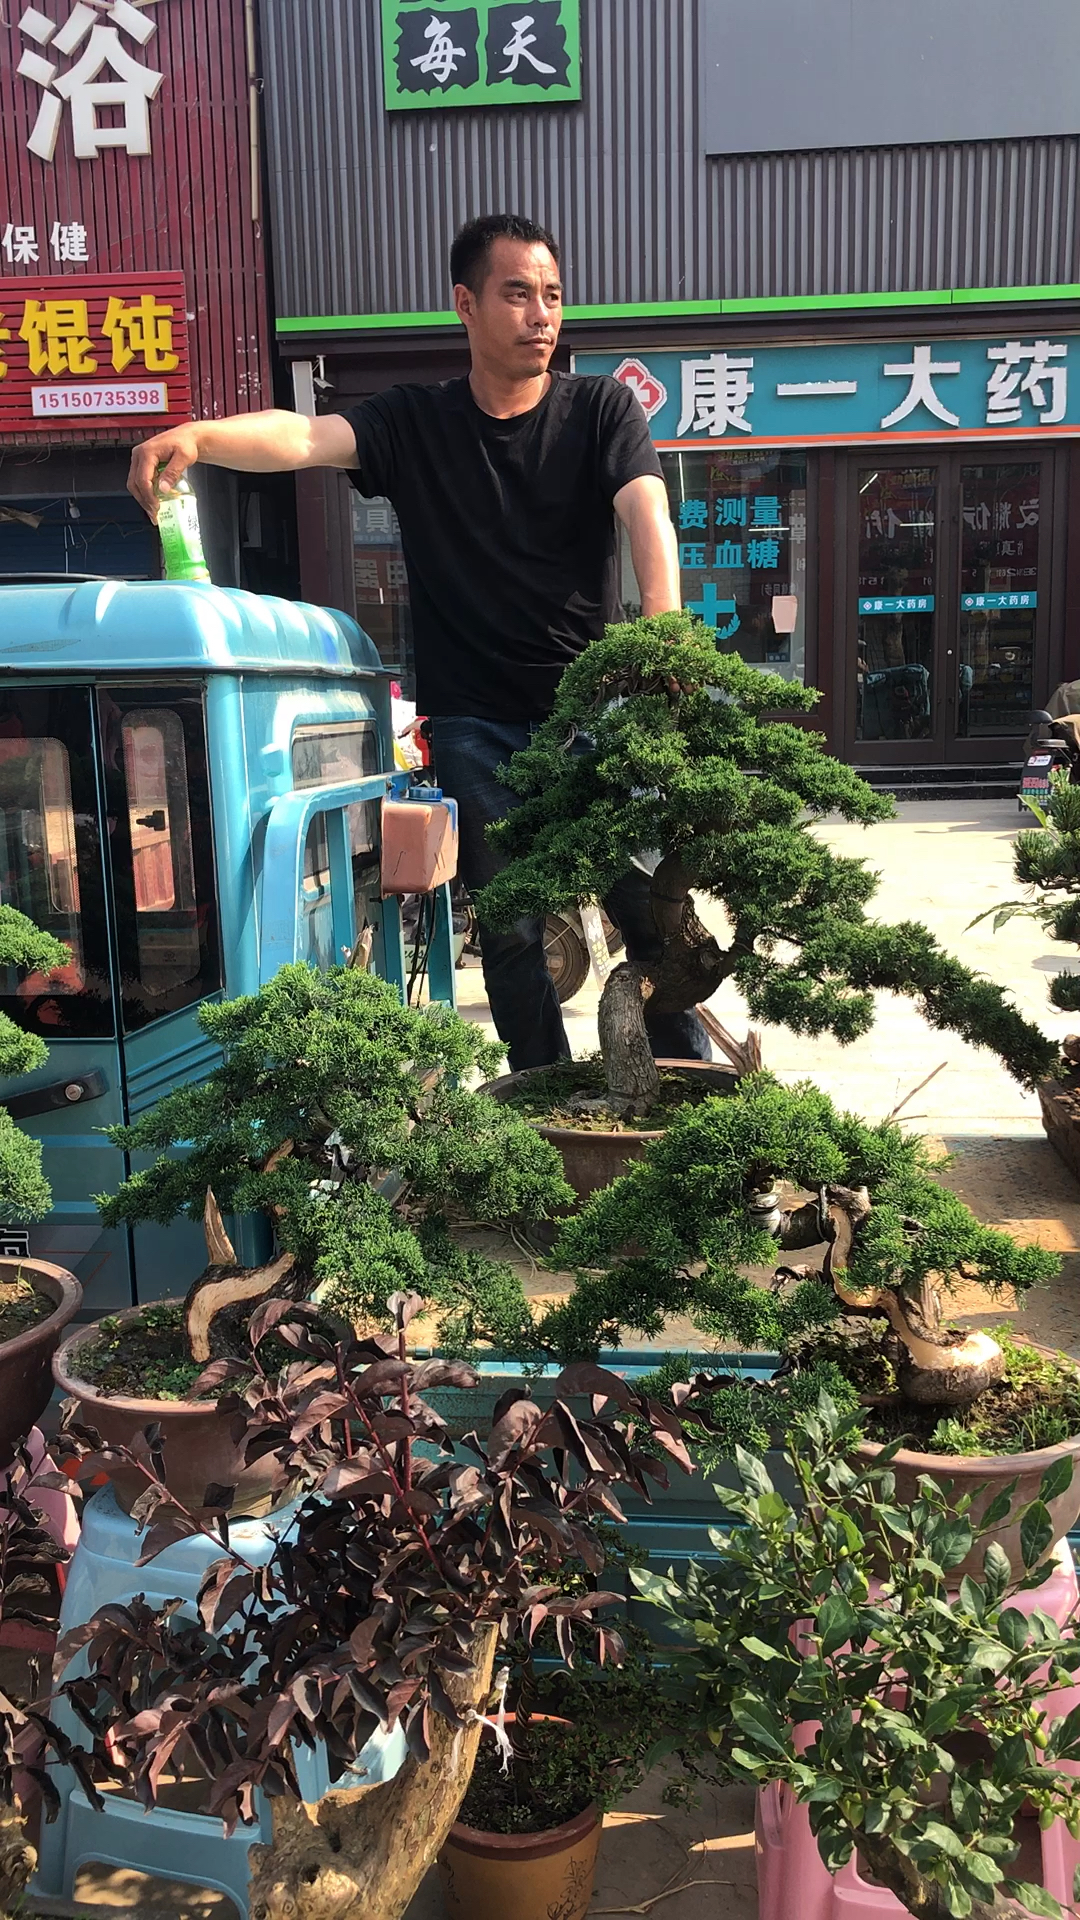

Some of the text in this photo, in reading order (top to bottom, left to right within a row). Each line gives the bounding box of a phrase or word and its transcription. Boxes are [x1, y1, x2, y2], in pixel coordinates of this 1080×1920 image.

[410, 15, 557, 83] 每天
[17, 0, 166, 162] 浴
[1, 221, 90, 264] 保健
[39, 389, 160, 409] 15150735398
[676, 340, 1068, 437] 康一大药
[678, 495, 782, 530] 费测量
[679, 537, 780, 569] 压血糖
[874, 599, 928, 611] 康一大药房
[975, 595, 1030, 607] 康一大药房
